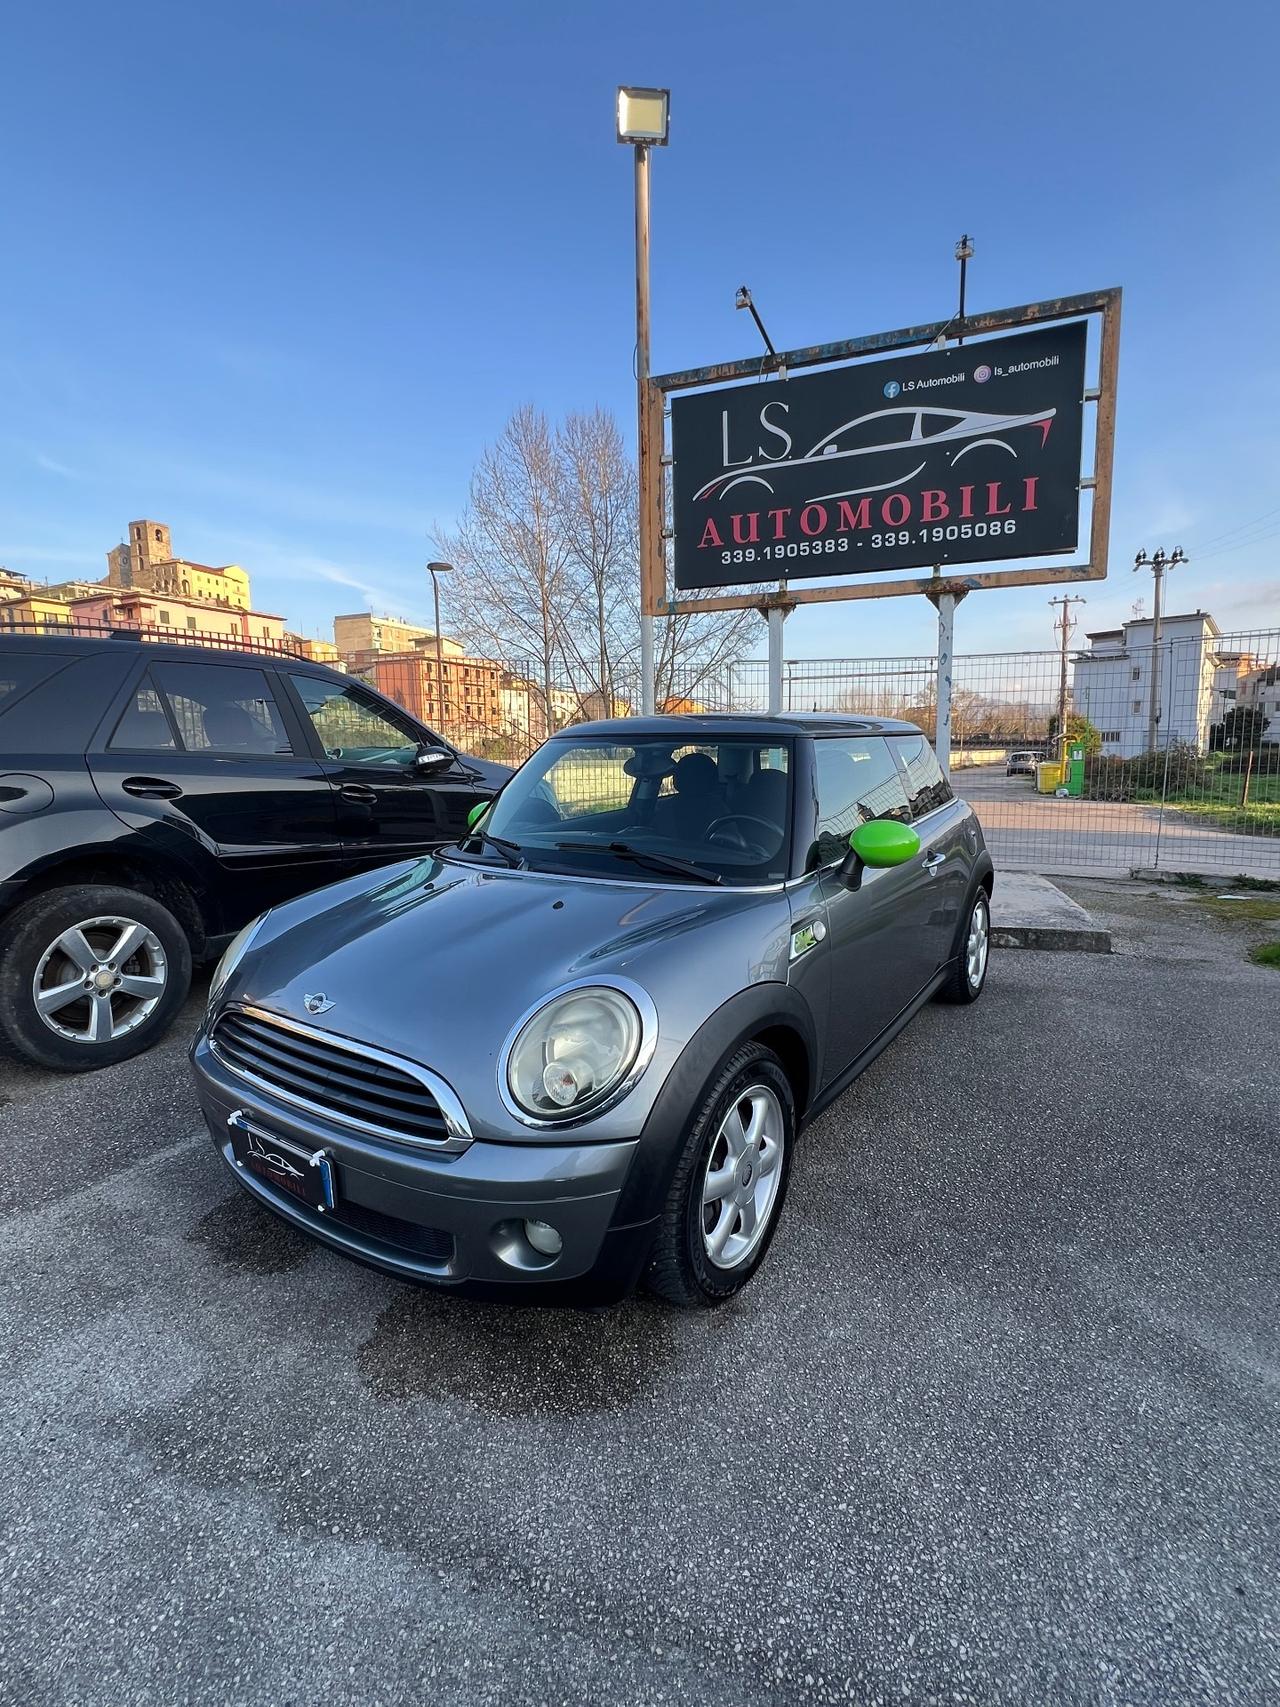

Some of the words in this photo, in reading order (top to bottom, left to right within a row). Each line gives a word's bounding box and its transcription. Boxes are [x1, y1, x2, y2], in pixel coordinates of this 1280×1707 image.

[902, 380, 915, 392] LS
[917, 372, 965, 390] Automobili
[994, 355, 1060, 377] ls_automobili
[697, 476, 1040, 548] AUTOMOBILI
[721, 537, 849, 565] 339.1905383
[871, 519, 1016, 548] 339.1905086
